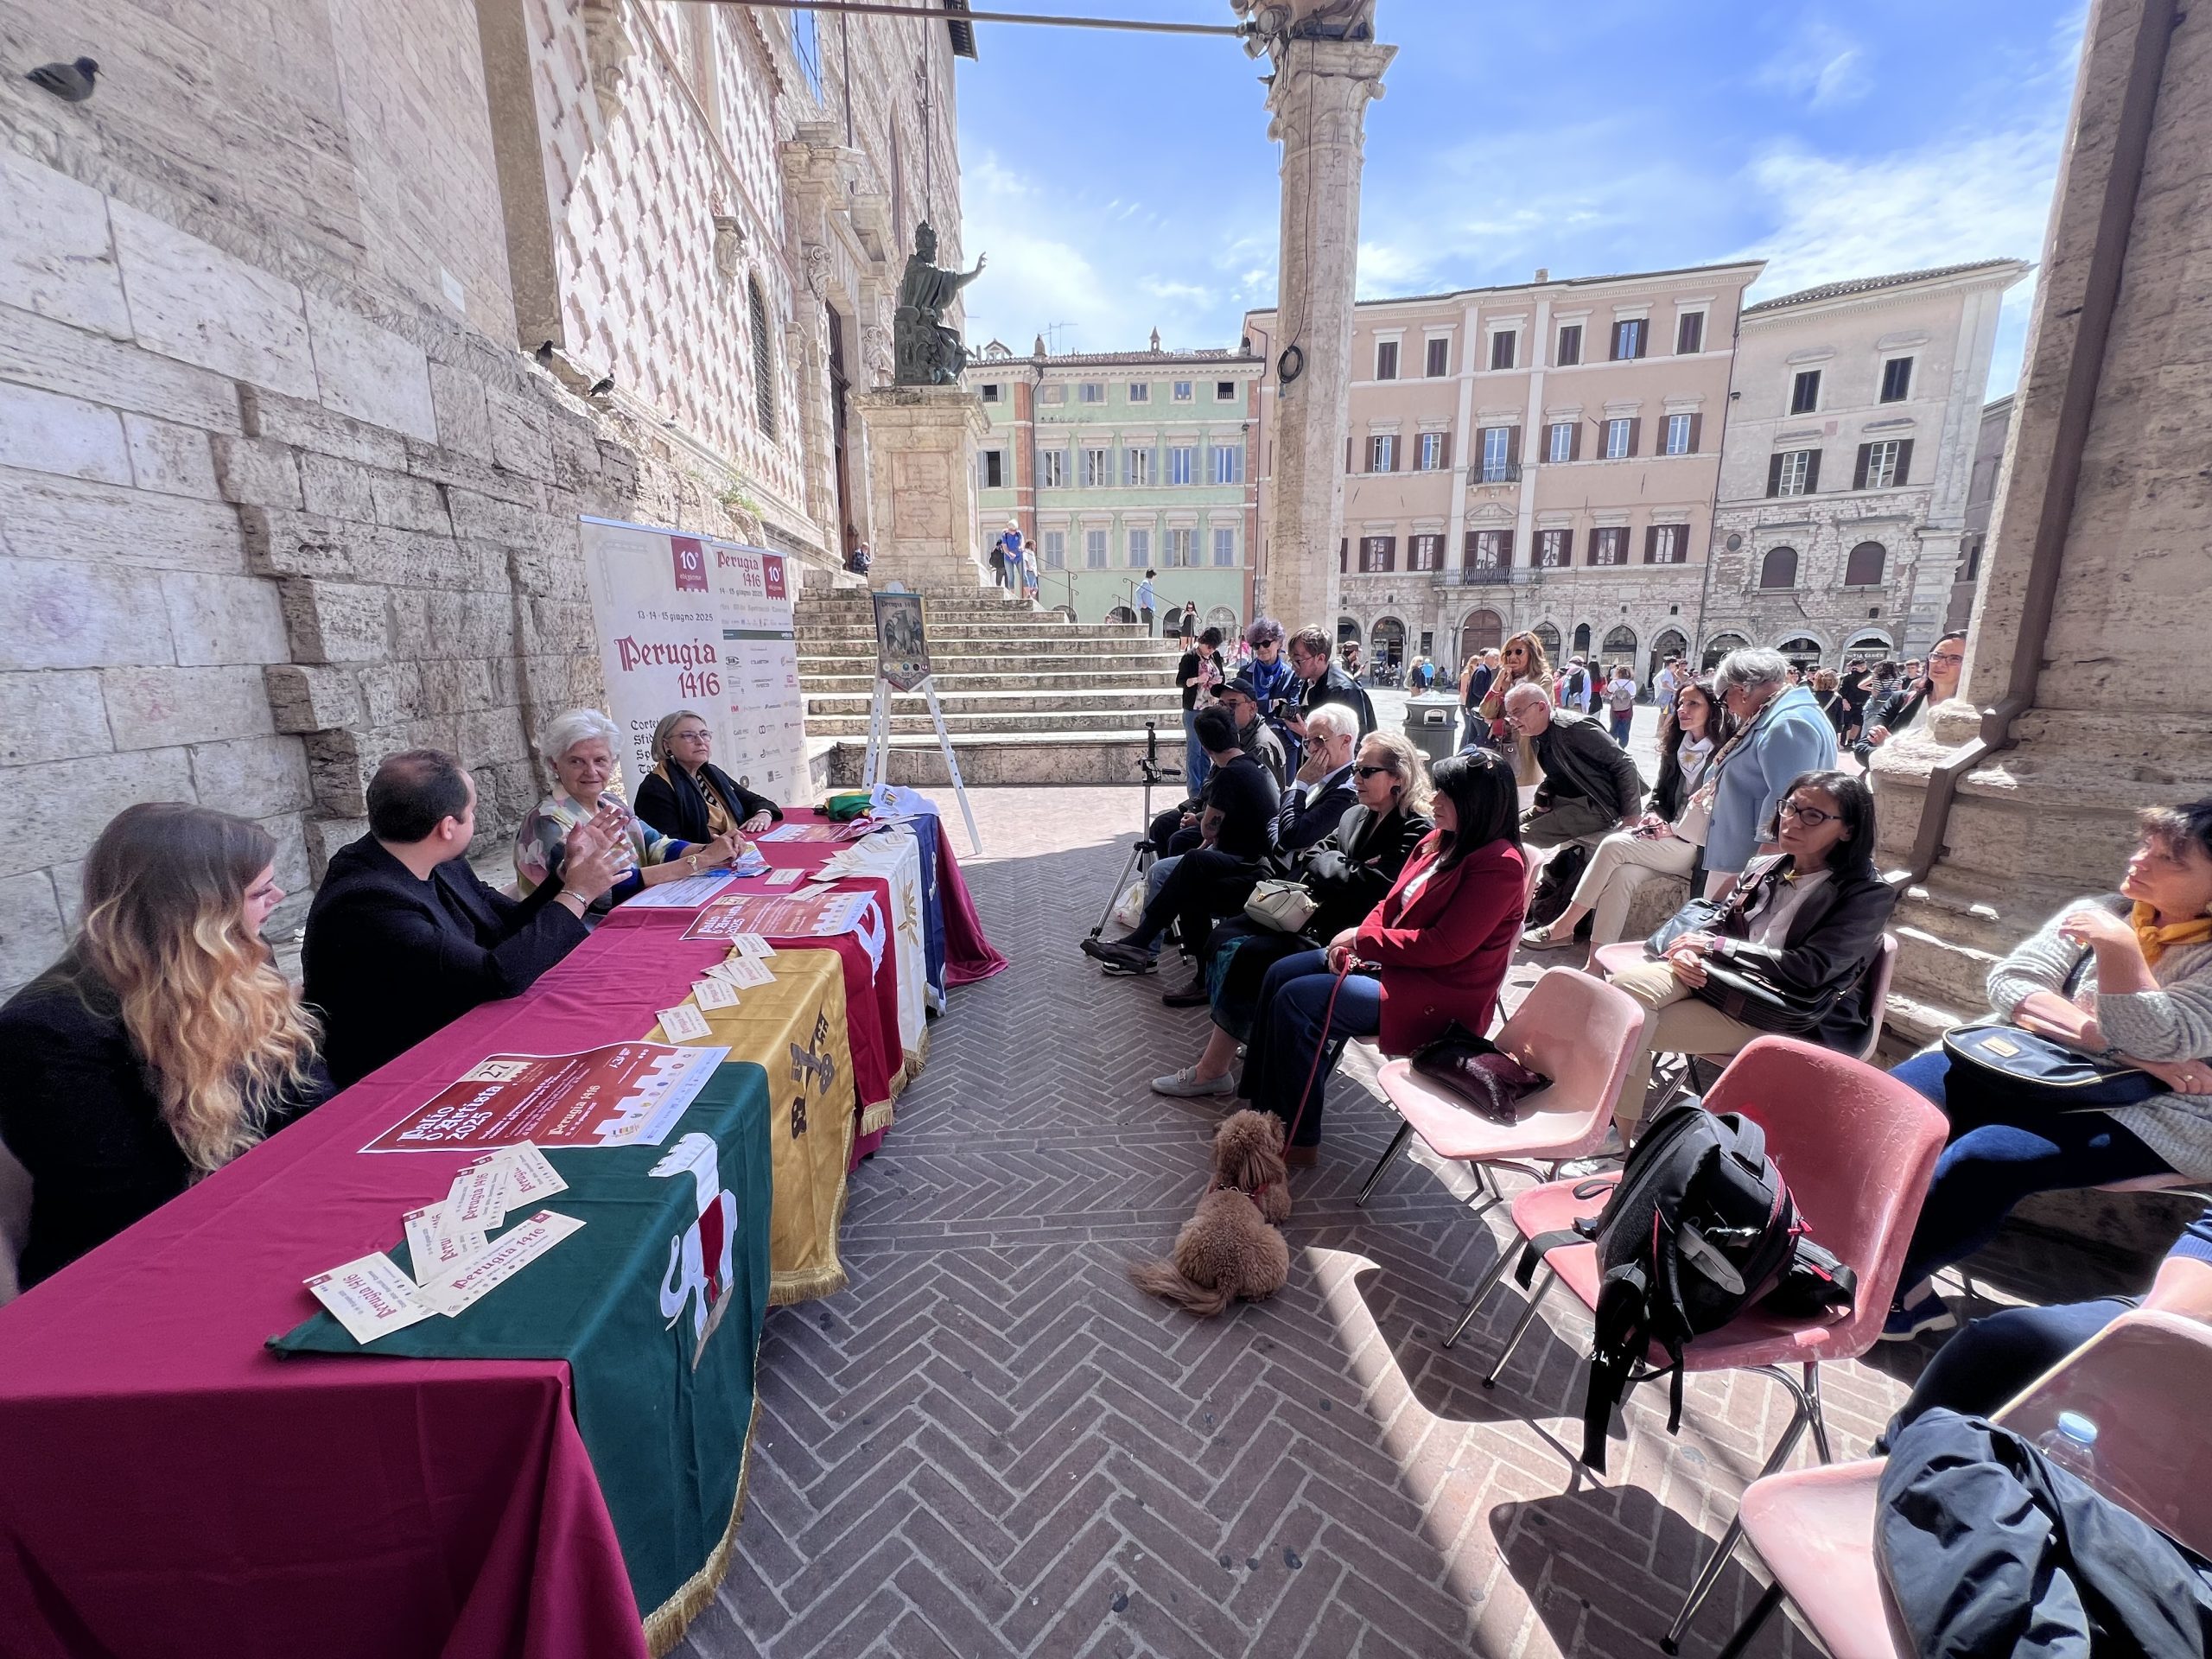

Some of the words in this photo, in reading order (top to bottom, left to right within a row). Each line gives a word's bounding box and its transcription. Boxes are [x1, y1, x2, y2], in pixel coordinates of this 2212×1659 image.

[717, 550, 759, 572] Perugia
[743, 573, 761, 587] 1416
[650, 611, 657, 620] 14
[669, 613, 694, 622] giugno
[614, 635, 718, 671] Perugia
[677, 671, 721, 699] 1416
[480, 1064, 510, 1078] 27
[397, 1106, 454, 1141] Palio
[548, 1099, 587, 1135] Perugia
[581, 1085, 601, 1100] 1416
[445, 1111, 493, 1141] 2025
[461, 1188, 485, 1222] Perugia
[450, 1248, 516, 1289] Perugia
[516, 1228, 545, 1246] 1416
[342, 1274, 363, 1289] 1416
[358, 1287, 397, 1319] Perugia
